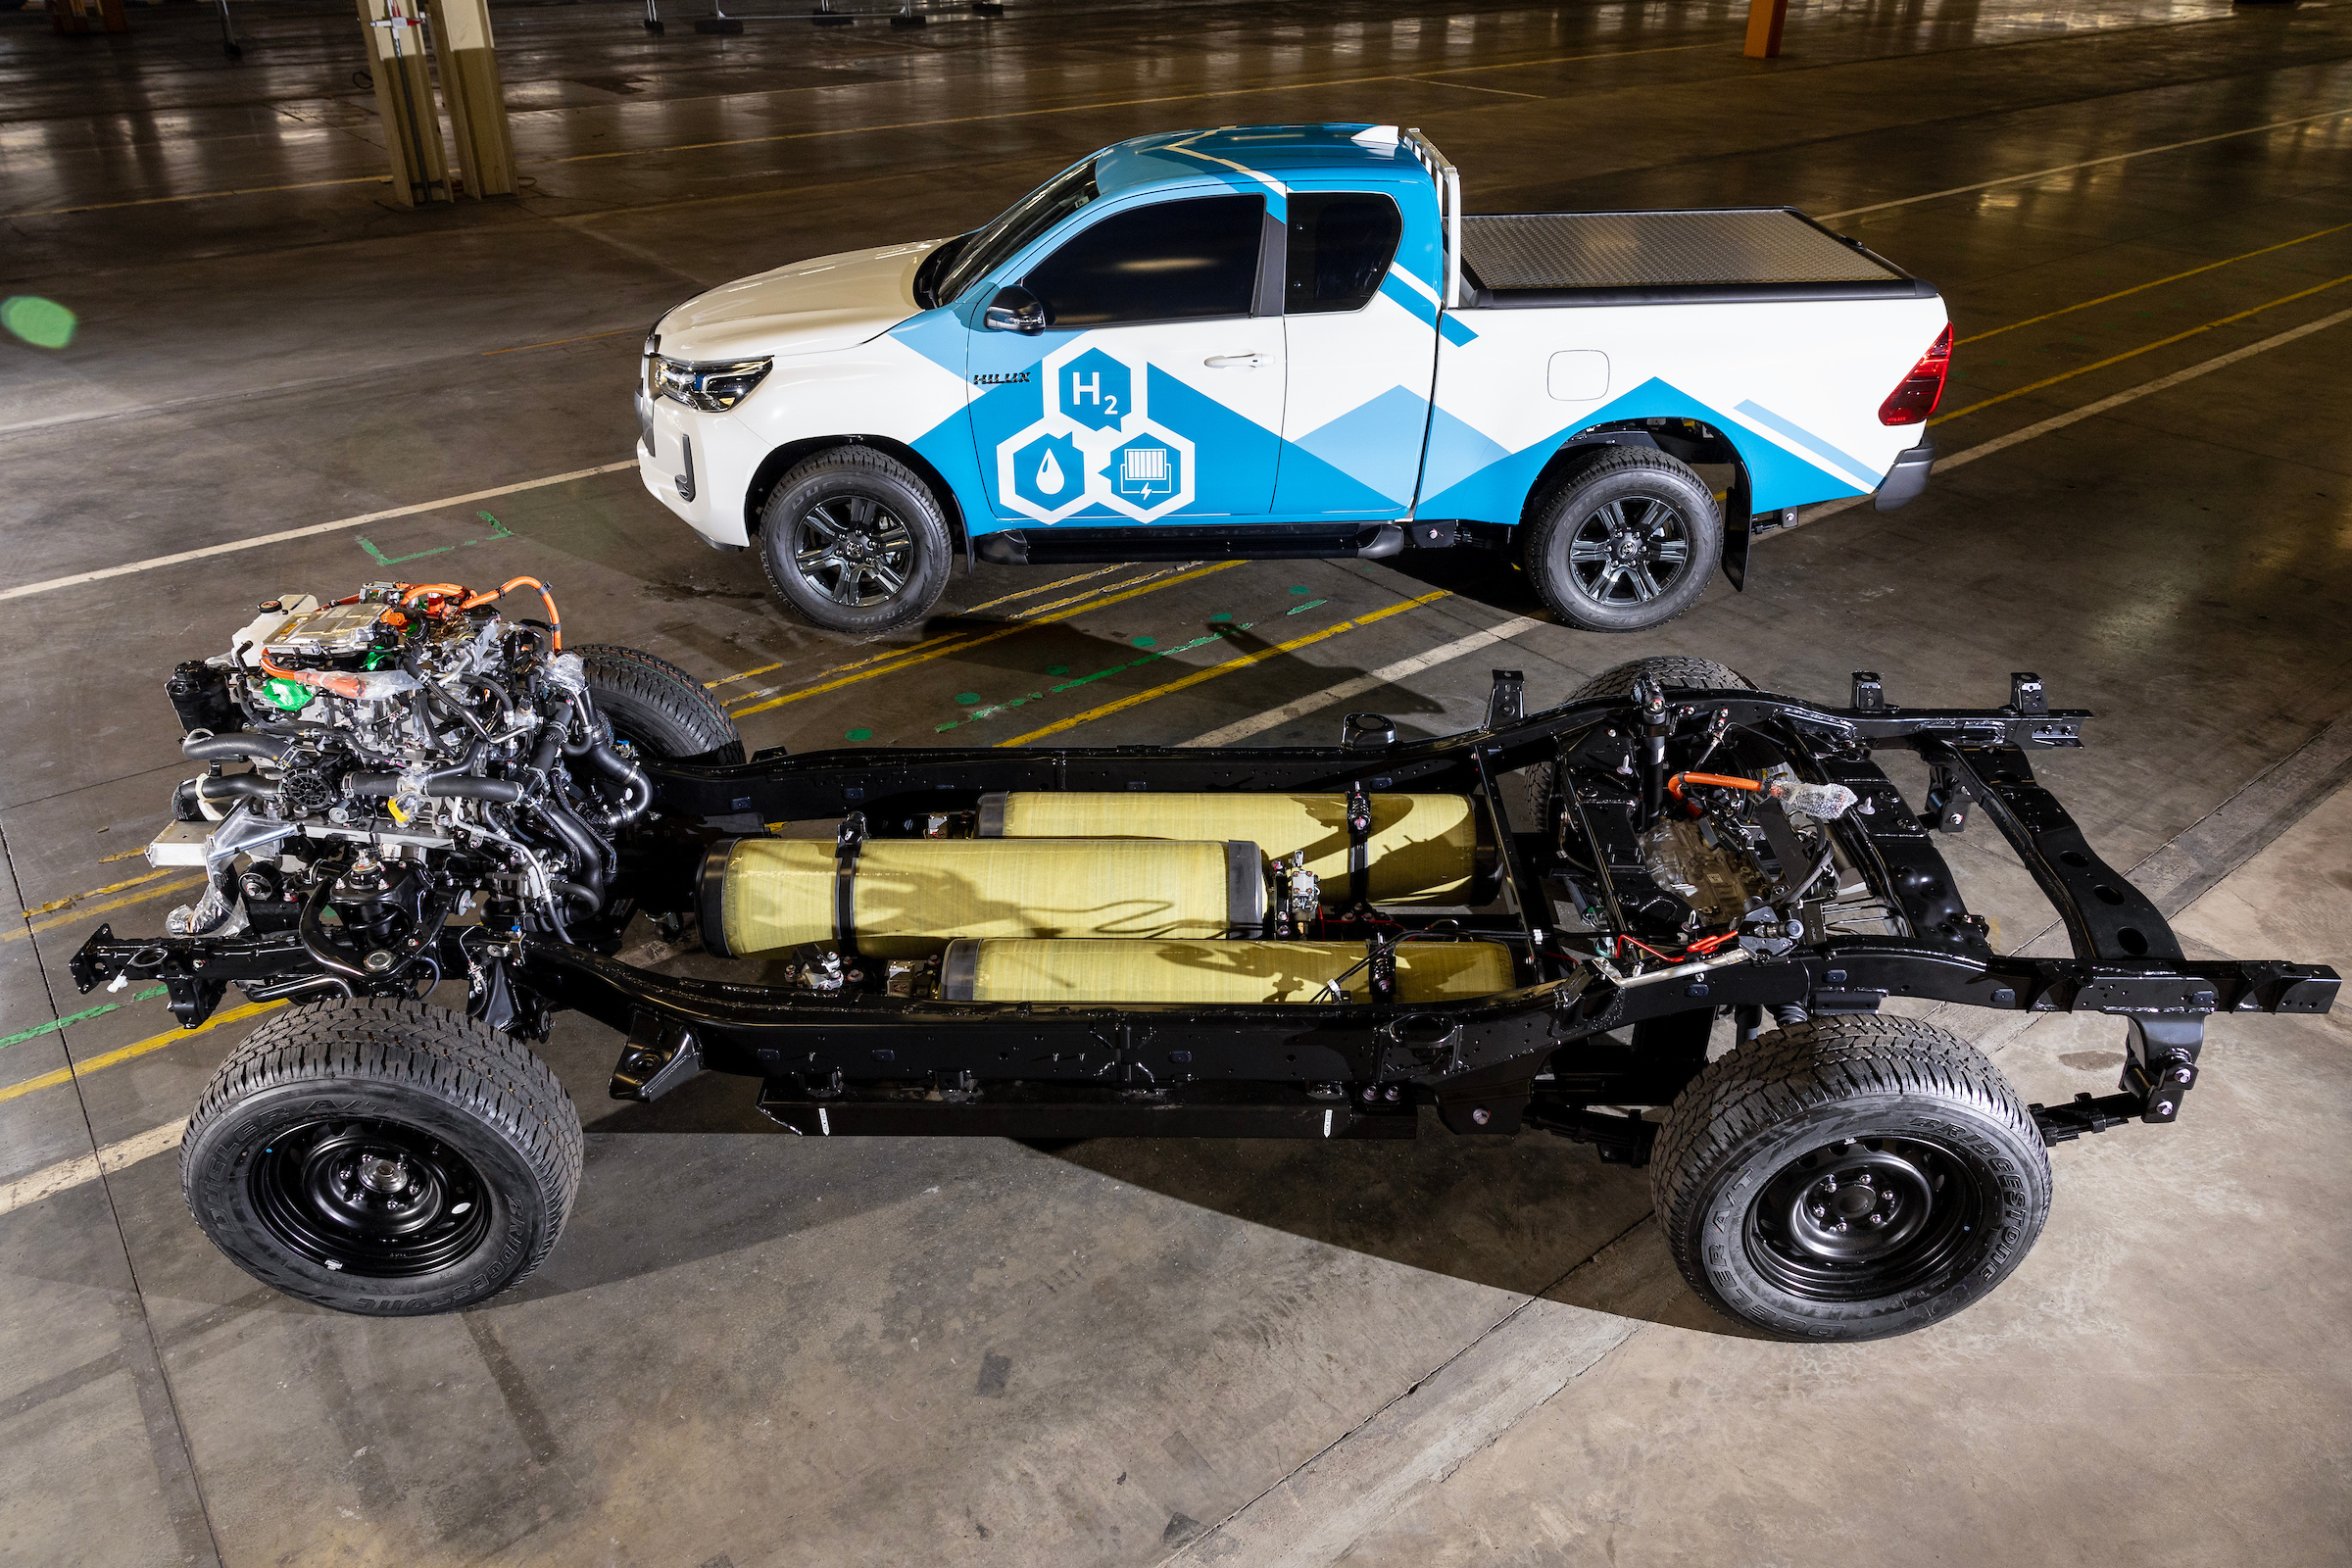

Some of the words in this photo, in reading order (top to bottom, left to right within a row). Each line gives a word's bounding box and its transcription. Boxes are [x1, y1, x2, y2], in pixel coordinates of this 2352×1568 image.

[973, 371, 1031, 384] HILUX
[204, 1106, 290, 1232] DUELER
[1713, 1167, 1754, 1234] A/T
[1909, 1115, 2026, 1282] BRIDGESTONE
[351, 1194, 525, 1311] BRIDGESTONE
[1708, 1244, 1846, 1337] DUELER
